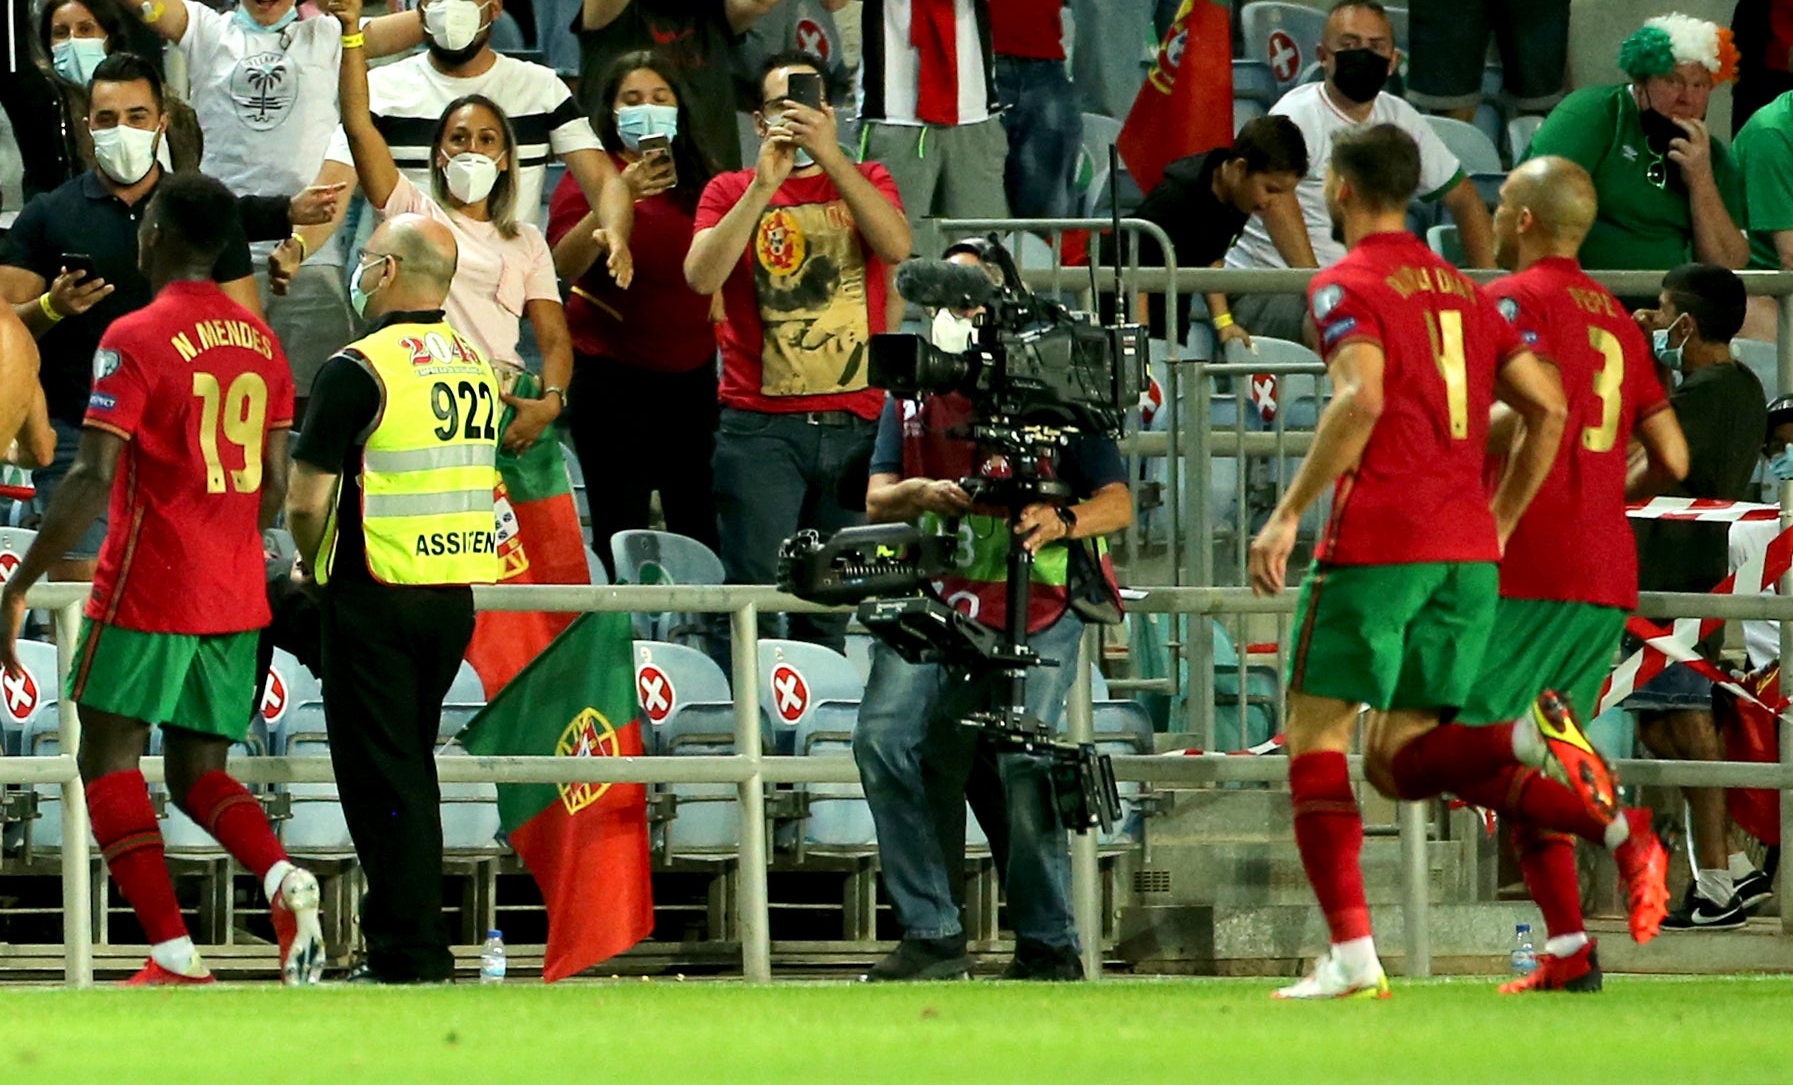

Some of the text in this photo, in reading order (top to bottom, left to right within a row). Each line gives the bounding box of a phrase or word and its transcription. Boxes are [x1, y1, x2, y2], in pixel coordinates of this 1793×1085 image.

[192, 371, 268, 494] 19
[431, 381, 495, 441] 922
[1582, 325, 1625, 452] 3
